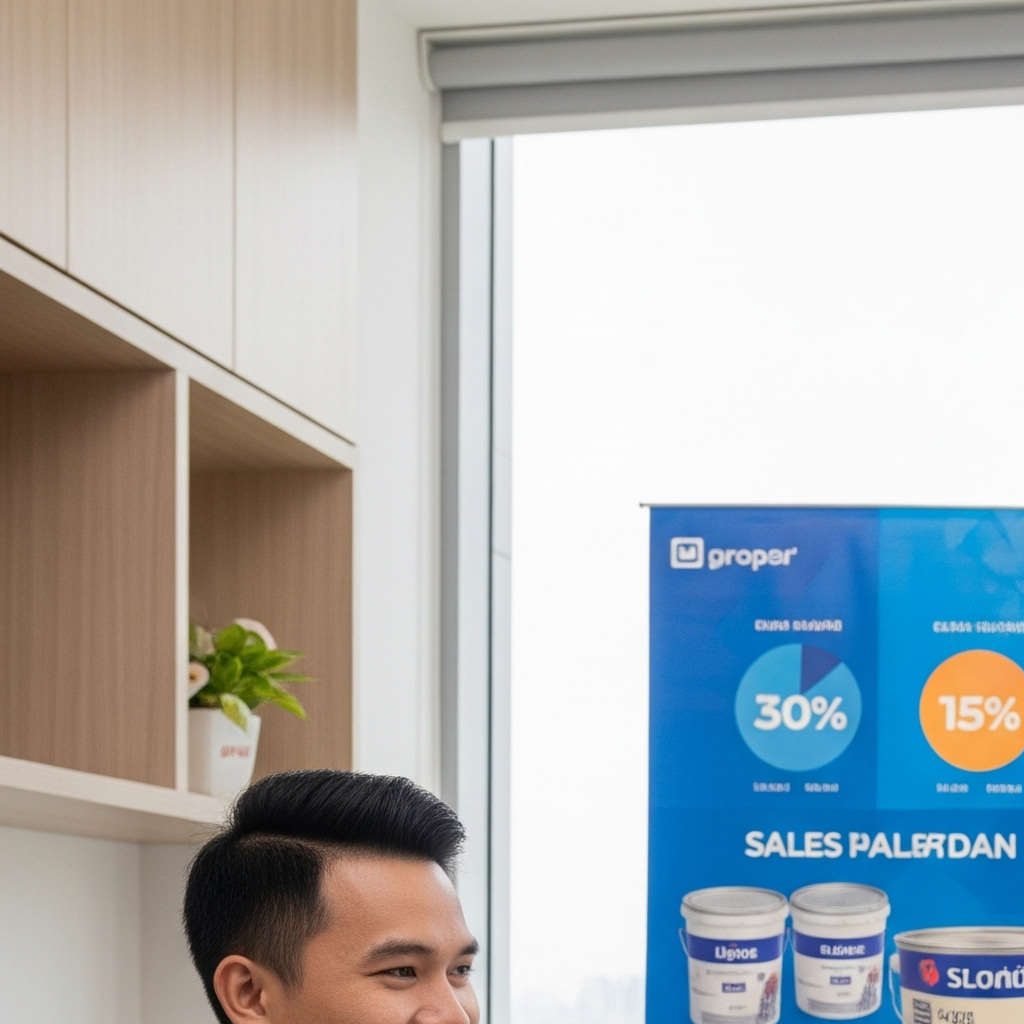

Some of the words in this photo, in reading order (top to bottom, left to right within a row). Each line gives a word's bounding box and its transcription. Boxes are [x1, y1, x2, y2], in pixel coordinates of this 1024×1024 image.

[708, 546, 798, 572] groper
[753, 693, 848, 731] 30%
[938, 695, 1021, 732] 15%
[744, 831, 843, 859] SALES
